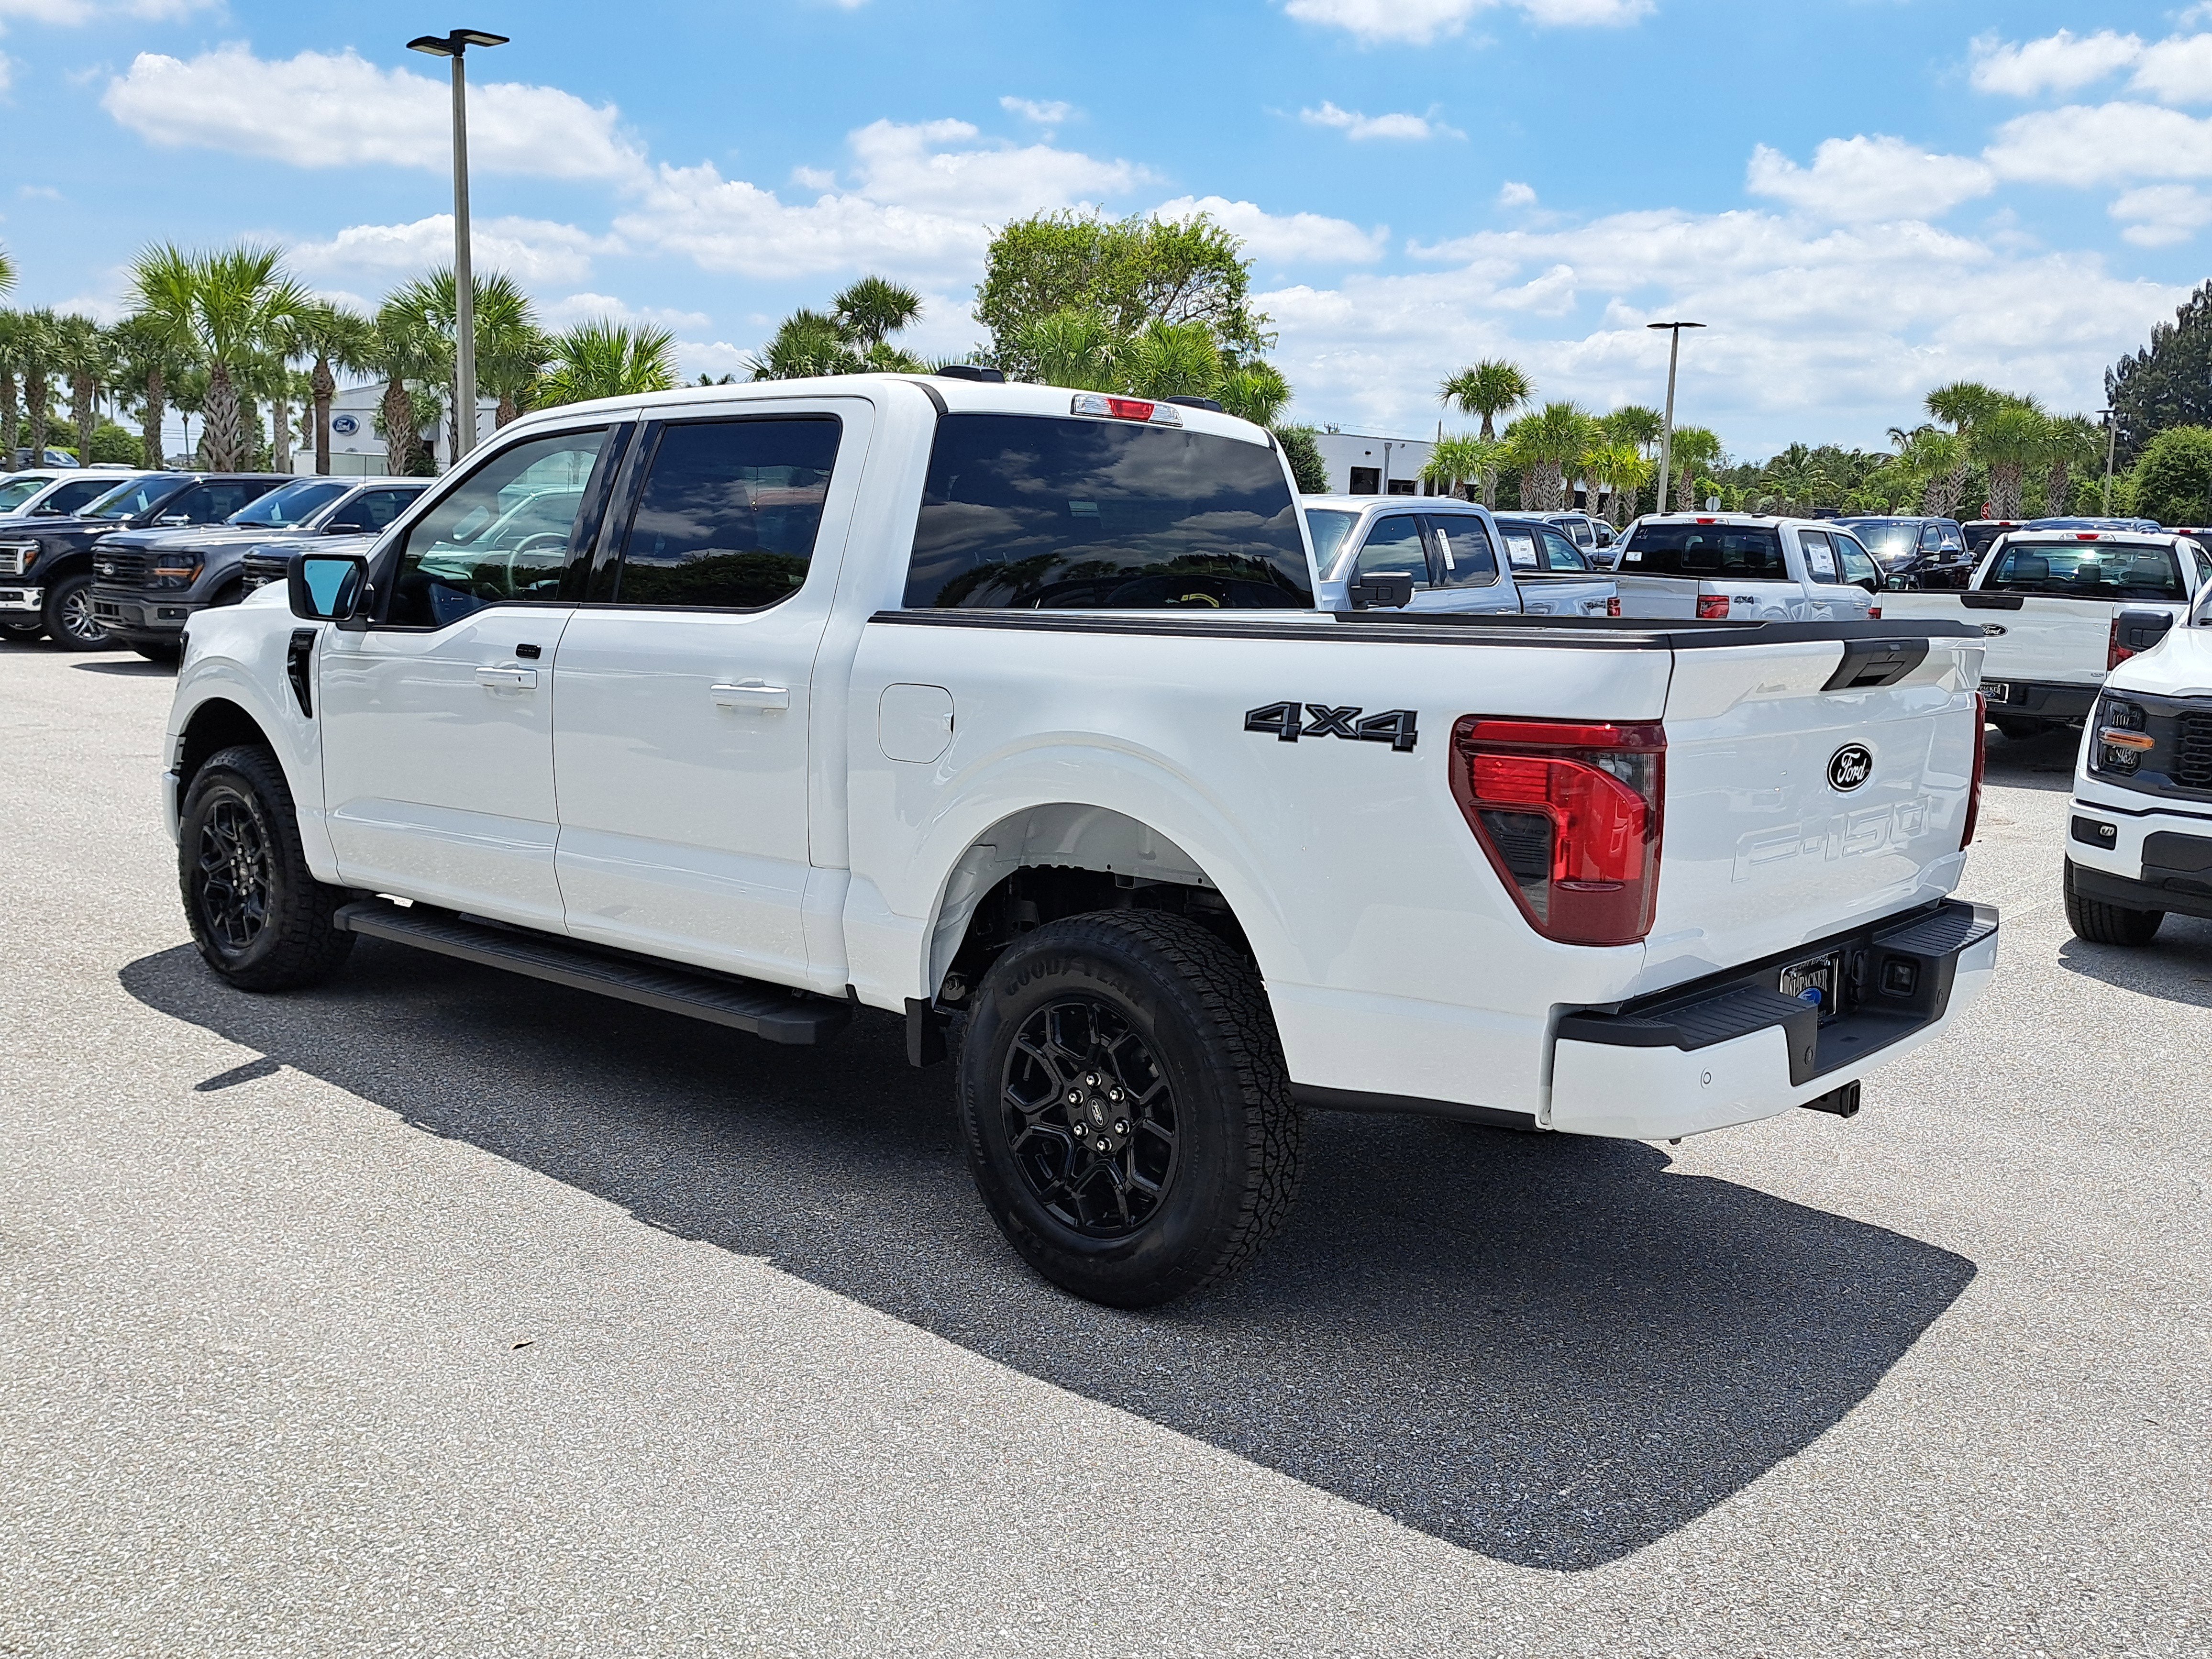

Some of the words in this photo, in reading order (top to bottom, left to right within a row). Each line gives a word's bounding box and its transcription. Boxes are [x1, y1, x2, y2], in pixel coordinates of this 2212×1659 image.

[1837, 752, 1868, 783] Ford
[1731, 795, 1932, 883] F-150
[1799, 968, 1827, 993] PACKER
